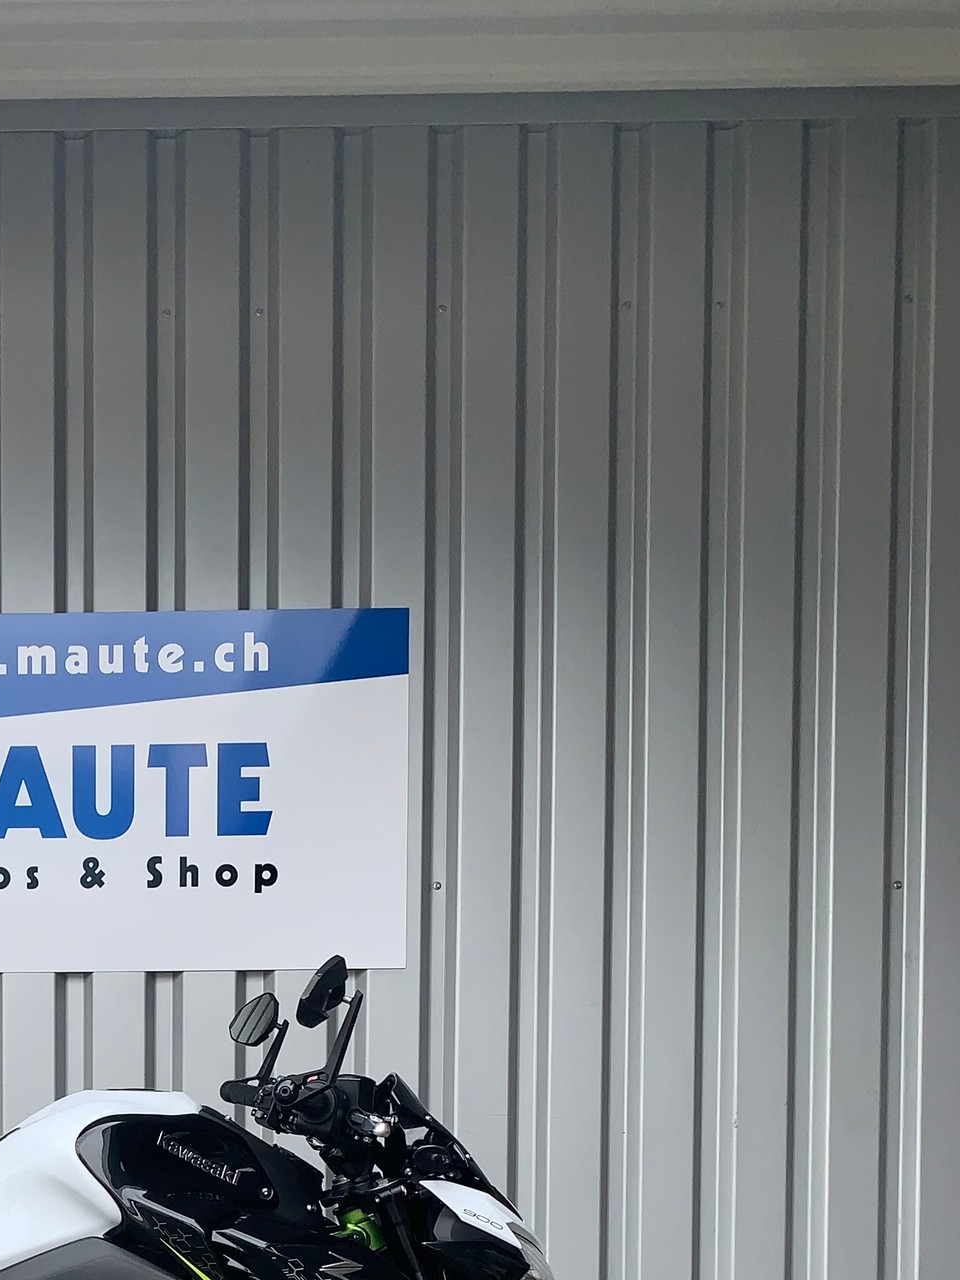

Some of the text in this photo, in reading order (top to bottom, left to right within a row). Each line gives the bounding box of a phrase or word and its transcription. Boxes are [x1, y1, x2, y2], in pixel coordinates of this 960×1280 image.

[80, 857, 106, 889] &
[146, 856, 279, 894] Shop
[156, 1130, 241, 1186] Kawasaki
[462, 1208, 504, 1231] 900
